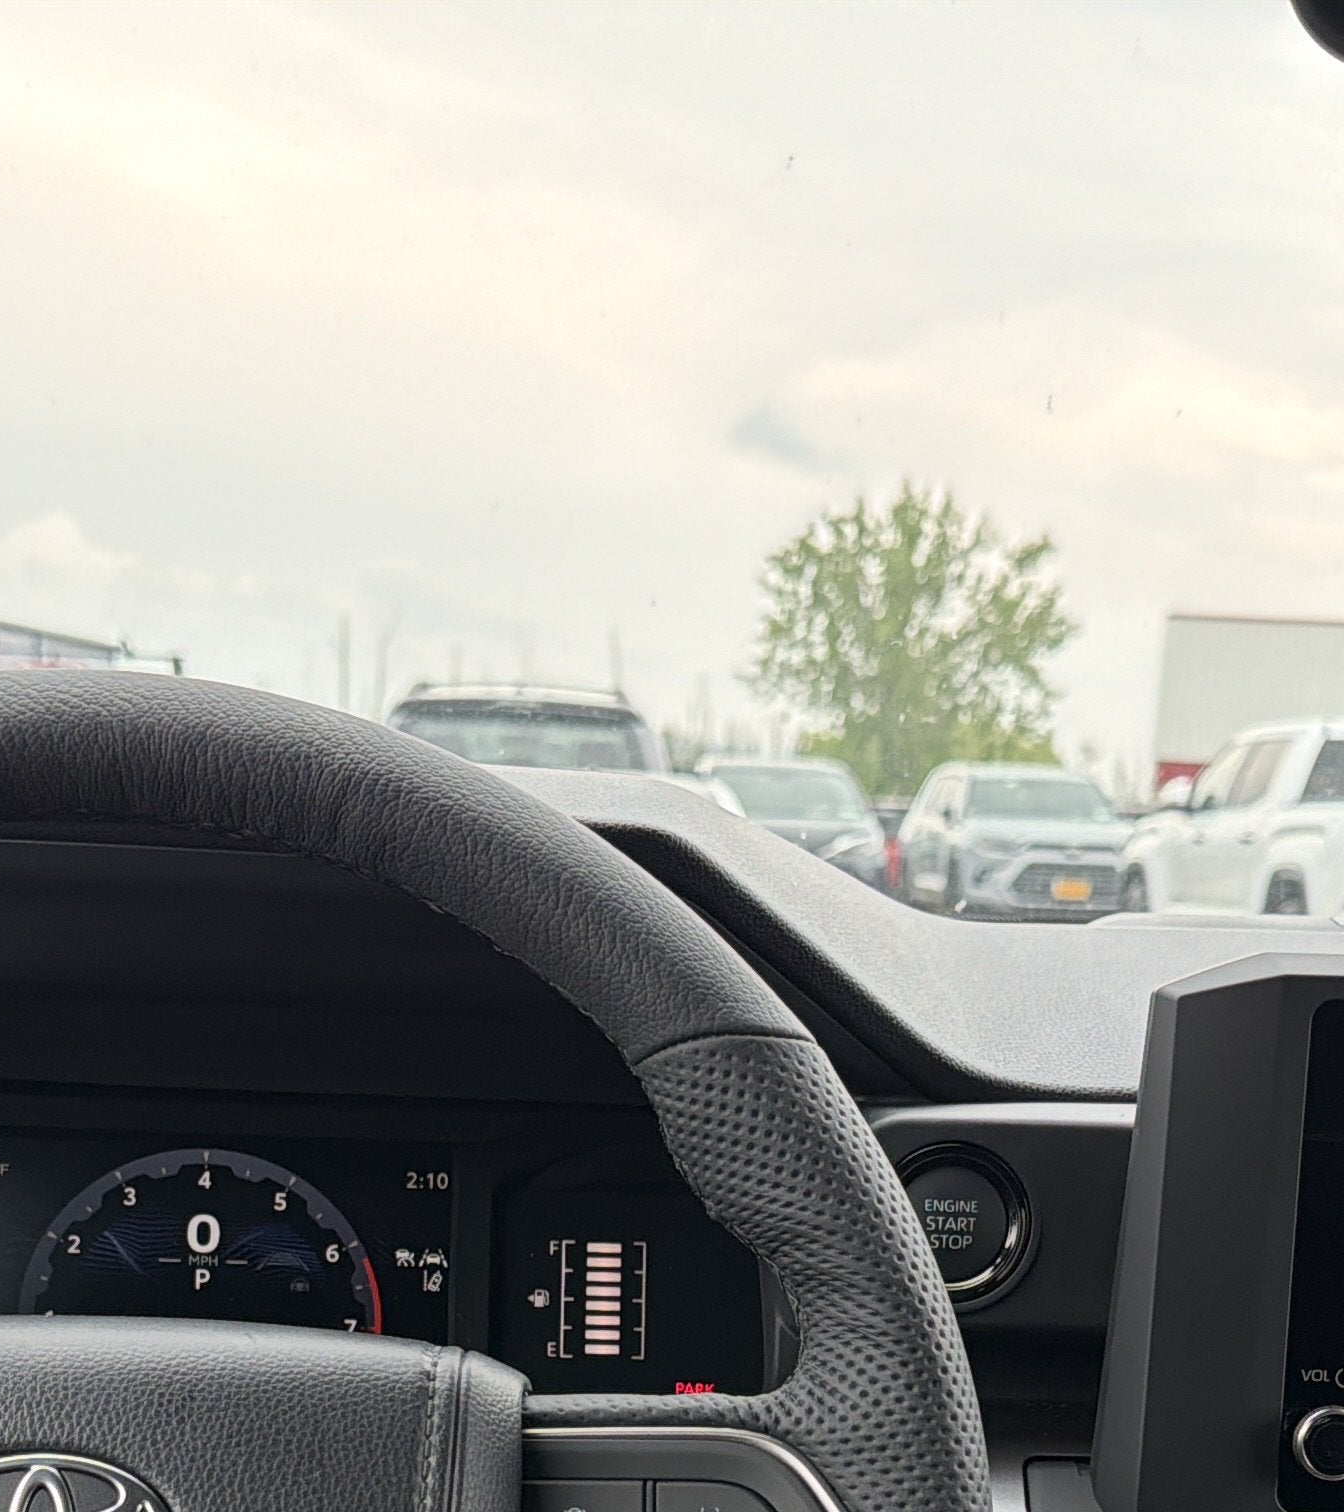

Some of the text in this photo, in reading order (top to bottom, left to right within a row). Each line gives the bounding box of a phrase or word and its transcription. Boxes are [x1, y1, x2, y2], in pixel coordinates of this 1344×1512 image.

[198, 1170, 212, 1190] 4
[406, 1171, 449, 1190] 2:10
[123, 1187, 136, 1206] 3
[273, 1192, 287, 1211] 5
[924, 1199, 979, 1213] ENGINE
[926, 1216, 976, 1232] START
[186, 1214, 220, 1254] 0
[930, 1234, 973, 1250] STOP
[67, 1235, 81, 1254] 2
[550, 1240, 559, 1256] F
[188, 1255, 219, 1267] MPH
[326, 1244, 339, 1263] 6
[194, 1269, 211, 1290] P
[344, 1319, 357, 1333] 7
[547, 1342, 557, 1357] E
[1301, 1369, 1330, 1382] VOL
